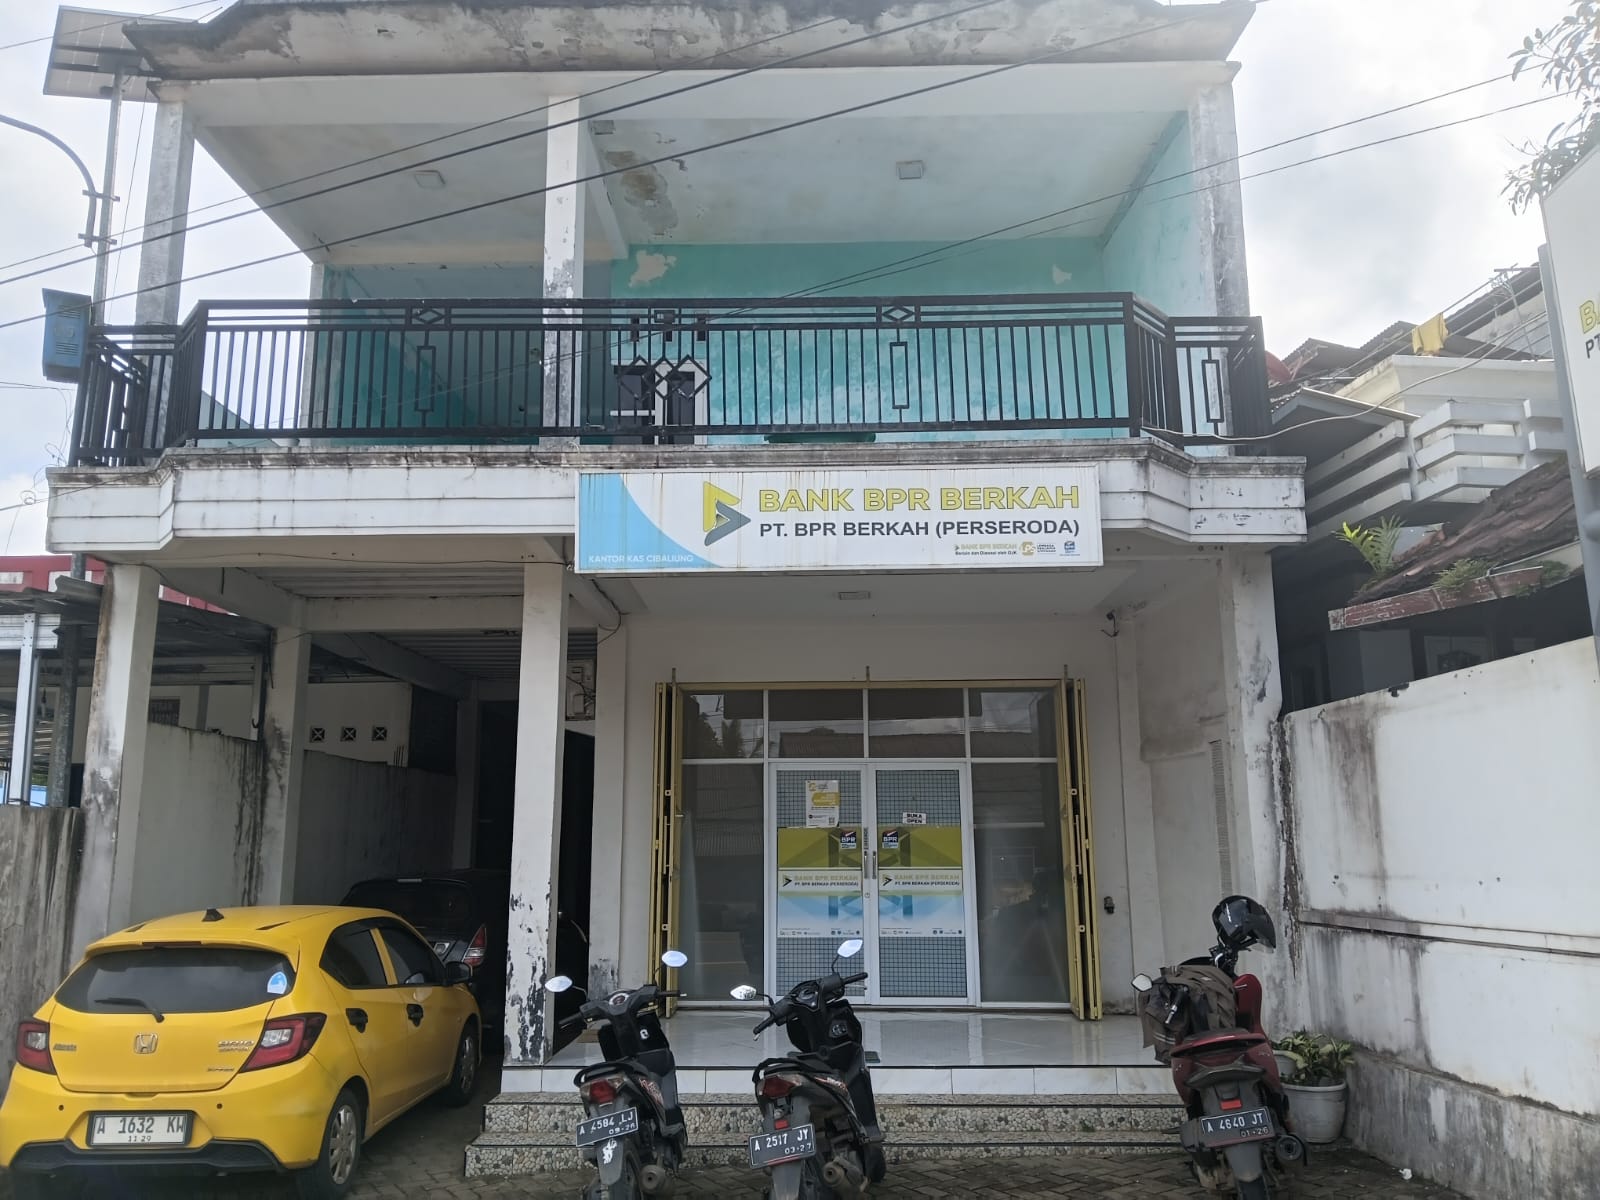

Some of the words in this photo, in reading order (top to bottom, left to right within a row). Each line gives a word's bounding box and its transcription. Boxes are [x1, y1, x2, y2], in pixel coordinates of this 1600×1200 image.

[758, 488, 854, 512] BANK
[863, 487, 930, 511] BPR
[939, 485, 1079, 510] BERKAH
[759, 523, 788, 537] PT.
[794, 522, 836, 537] BPR
[843, 521, 929, 536] BERKAH
[935, 519, 1080, 538] (PERSERODA)
[588, 554, 625, 563] KANTOR
[627, 554, 645, 562] KAS
[97, 1117, 106, 1134] A
[118, 1117, 155, 1134] 1632
[579, 1125, 586, 1136] A
[1207, 1121, 1214, 1134] A
[1219, 1116, 1246, 1130] 4640
[1251, 1112, 1263, 1125] JT
[754, 1139, 761, 1152] A
[766, 1133, 788, 1149] 2517
[797, 1128, 809, 1142] JY
